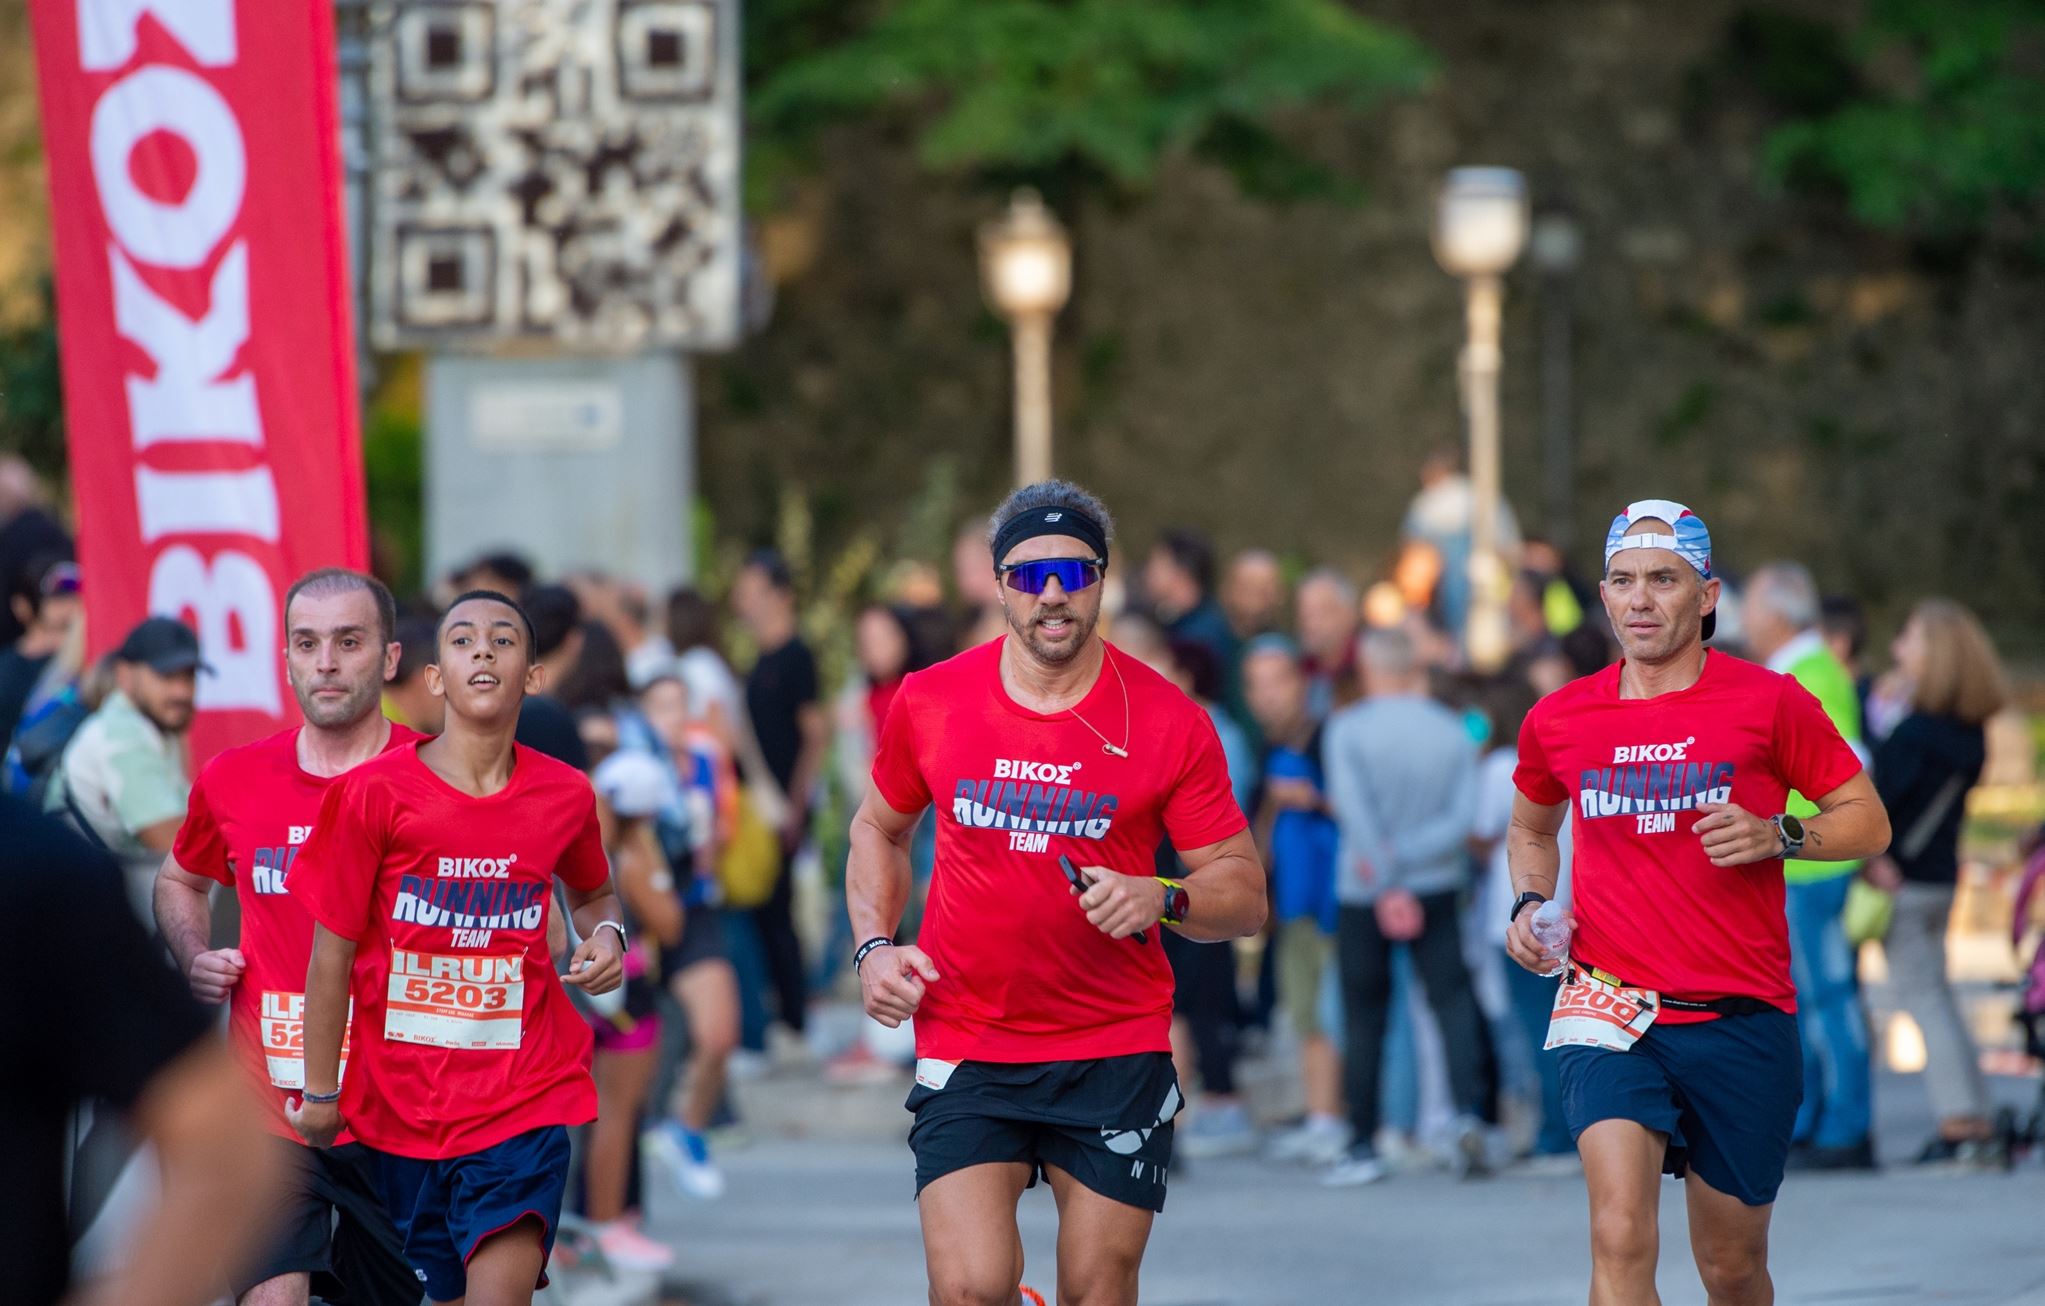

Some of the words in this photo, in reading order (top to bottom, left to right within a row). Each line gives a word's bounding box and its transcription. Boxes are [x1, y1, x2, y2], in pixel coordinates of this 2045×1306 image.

[1580, 762, 1735, 819] RUNNING
[953, 779, 1119, 841] RUNNING
[1636, 813, 1675, 834] TEAM
[1009, 832, 1049, 854] TEAM
[392, 874, 544, 930] RUNNING
[451, 928, 492, 948] TEAM
[393, 951, 522, 983] ILRUN
[404, 979, 508, 1009] 5203
